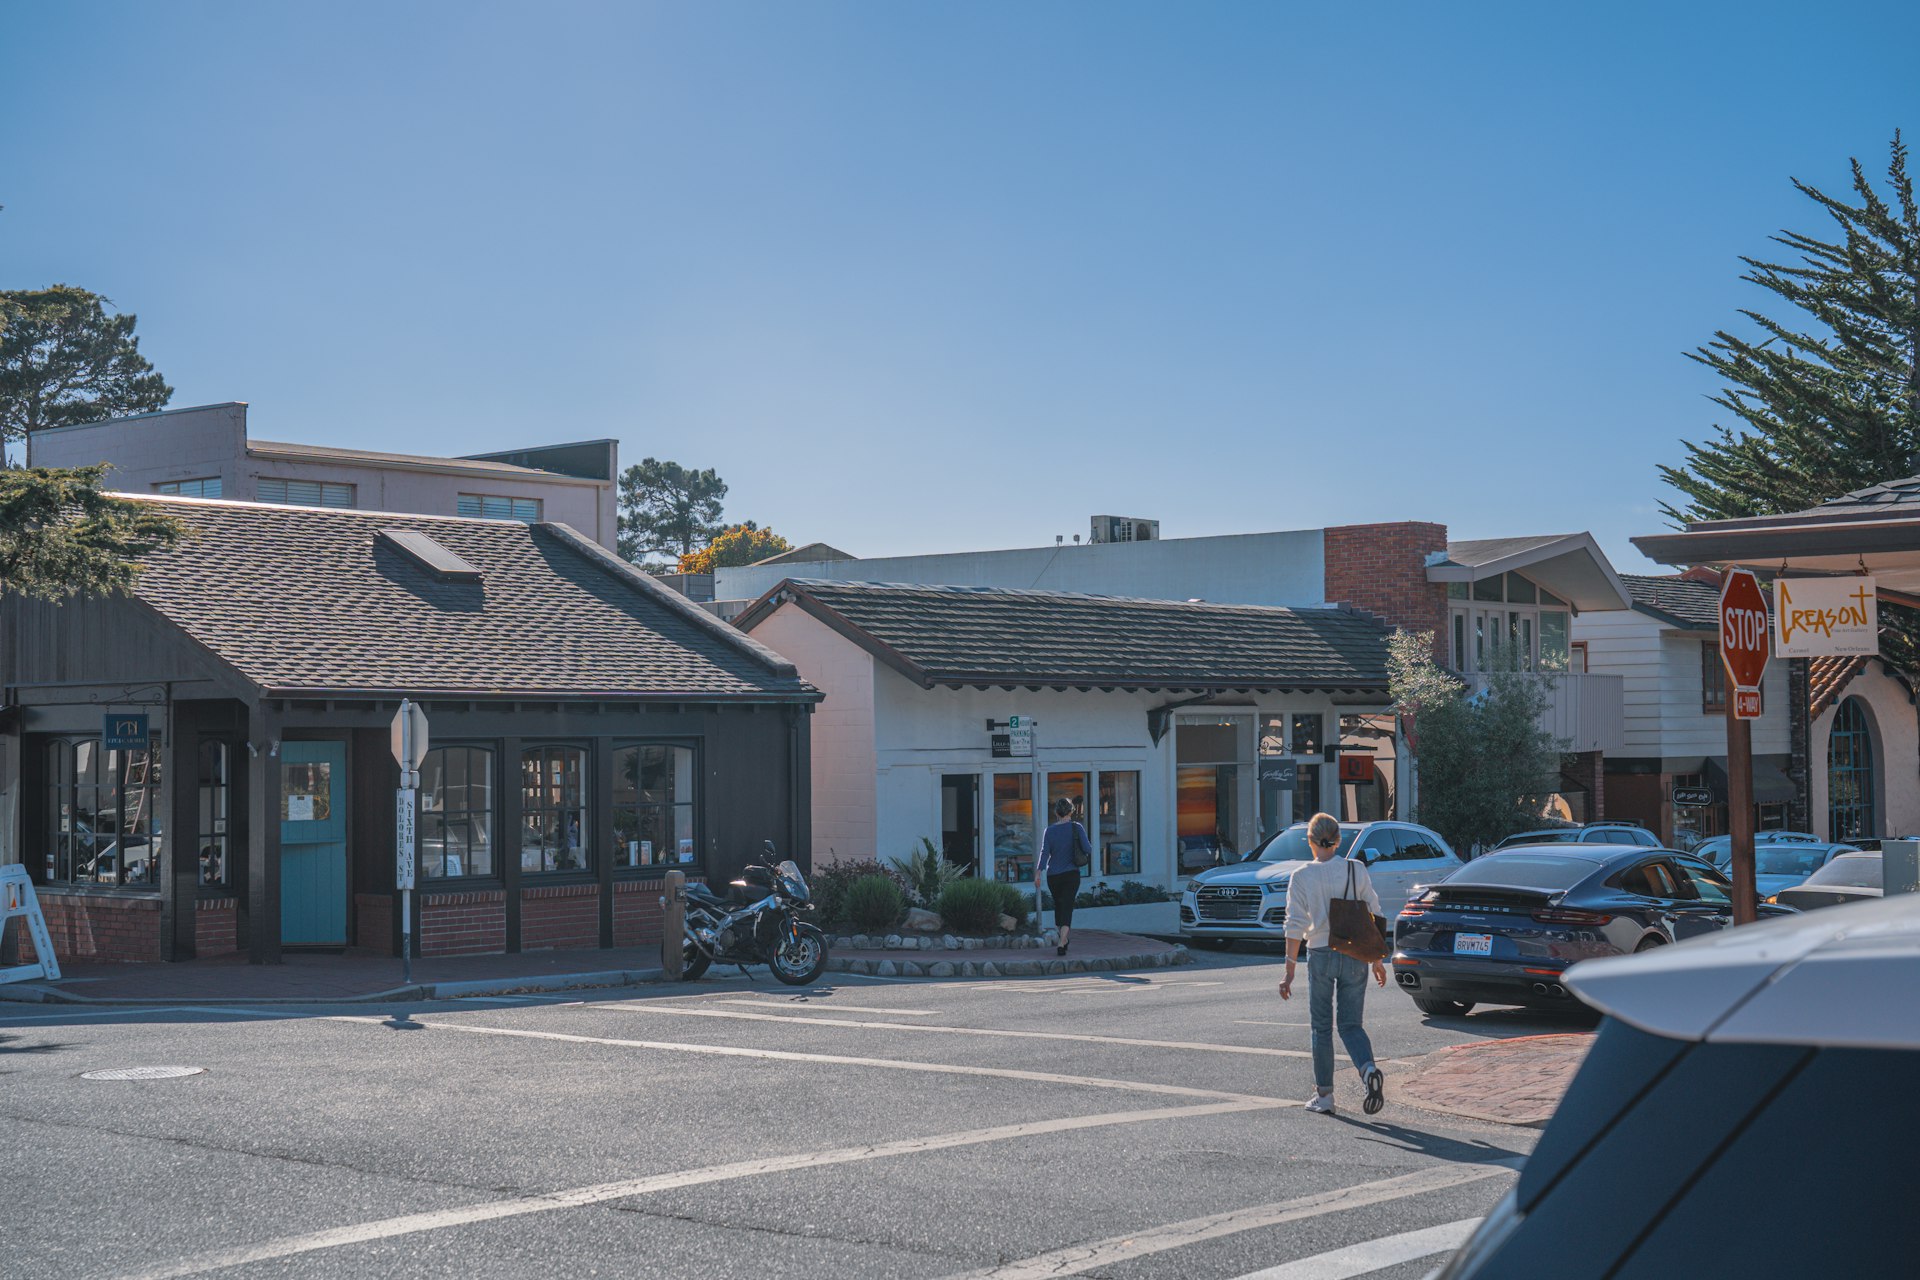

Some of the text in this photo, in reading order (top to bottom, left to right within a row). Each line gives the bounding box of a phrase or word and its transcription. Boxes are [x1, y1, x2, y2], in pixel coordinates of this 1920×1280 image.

[1780, 581, 1874, 644] CREASON
[1726, 607, 1765, 651] STOP
[1738, 696, 1759, 713] 4-WAY
[1011, 717, 1018, 727] 2
[1010, 730, 1031, 738] PARKING
[398, 865, 404, 882] ST
[1445, 904, 1510, 913] PORSCHE
[1456, 940, 1489, 952] 8RVM745
